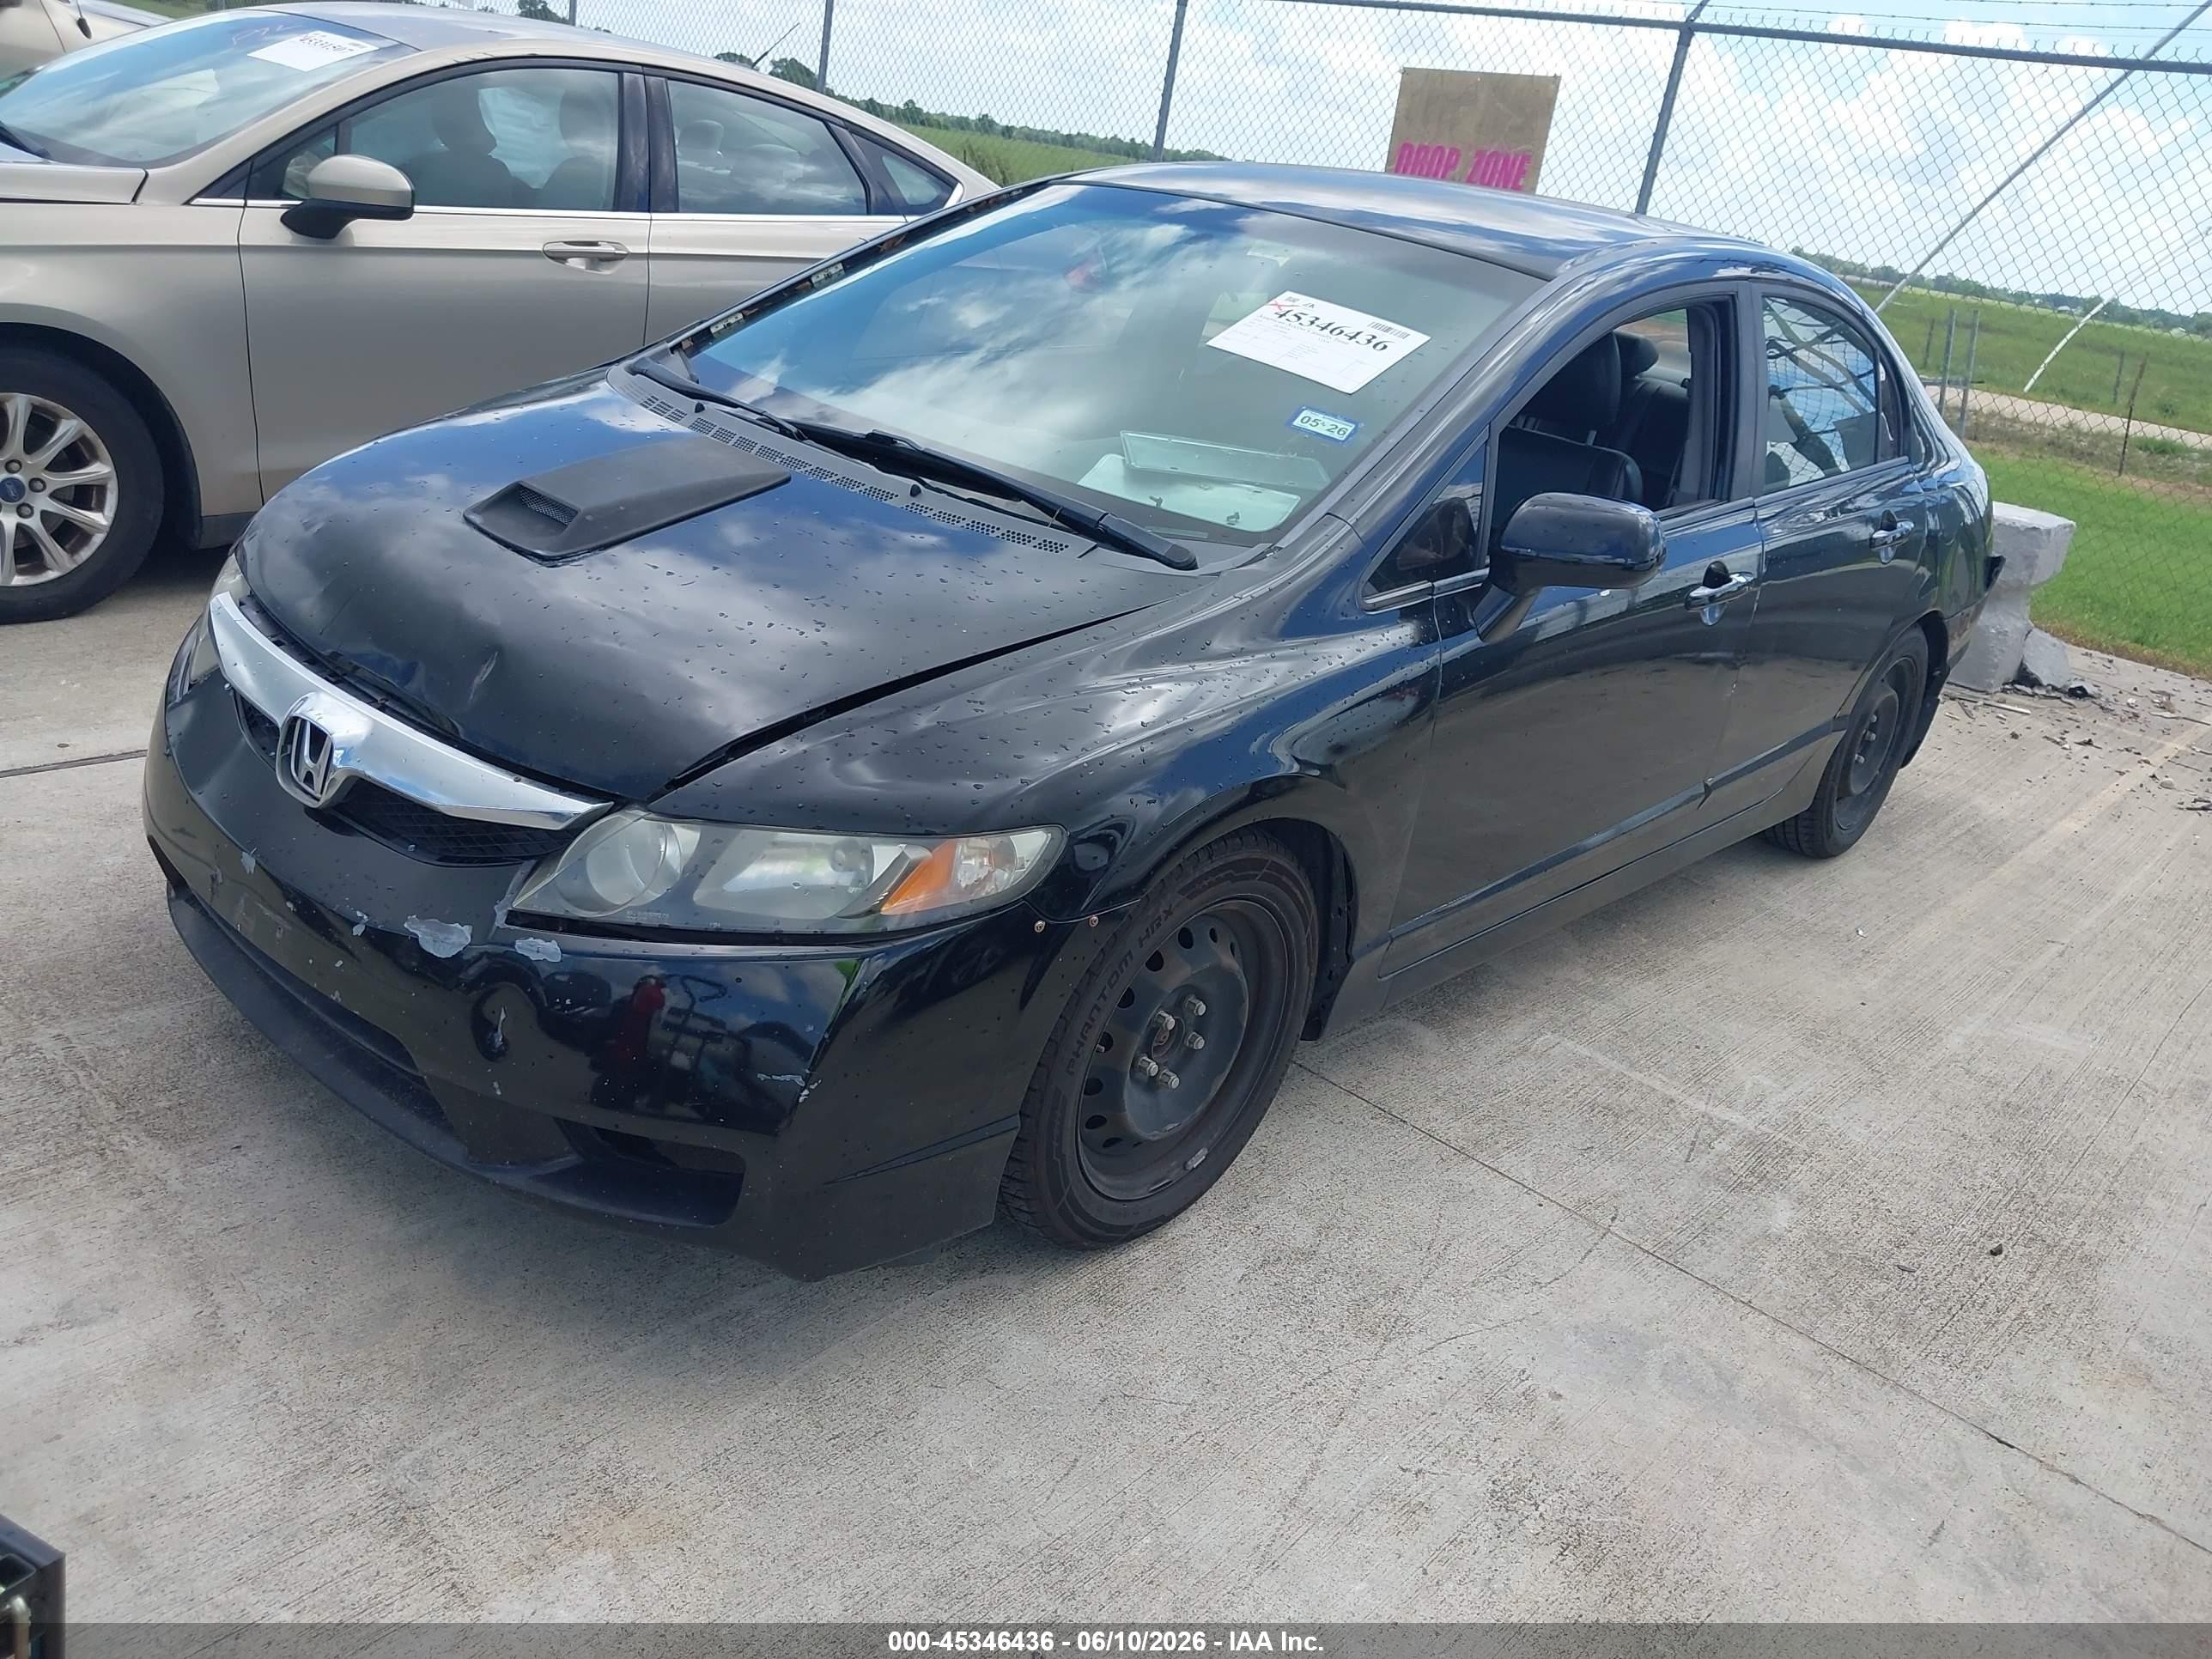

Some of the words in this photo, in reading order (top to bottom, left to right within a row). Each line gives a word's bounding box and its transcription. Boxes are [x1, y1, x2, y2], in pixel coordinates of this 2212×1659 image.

[1395, 143, 1461, 179] DROP
[1468, 150, 1532, 191] ZONE
[1273, 308, 1389, 352] 45346436
[1300, 416, 1322, 428] 05
[1327, 423, 1349, 436] 26
[1065, 949, 1135, 1077] PHANTOM
[1137, 902, 1175, 950] HRX
